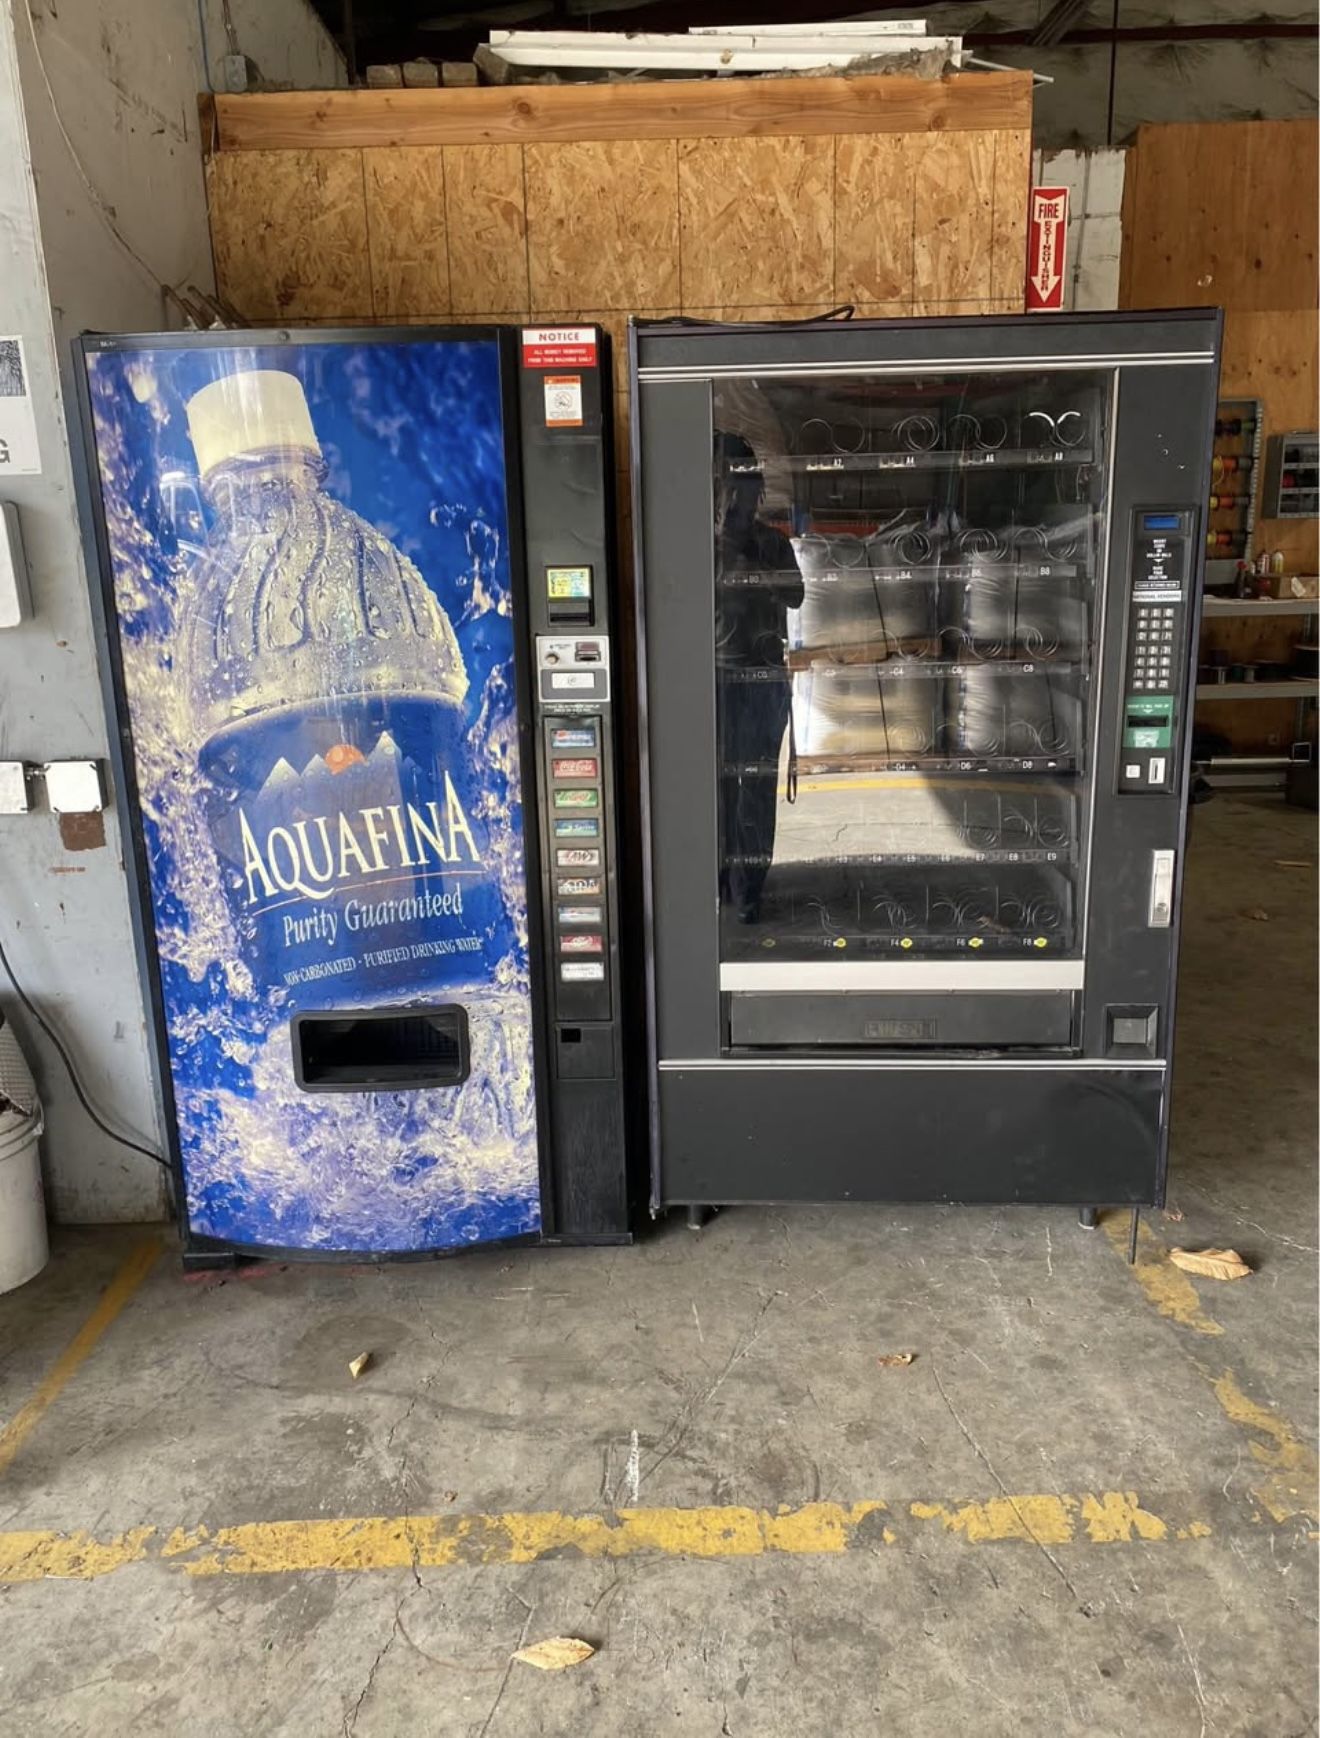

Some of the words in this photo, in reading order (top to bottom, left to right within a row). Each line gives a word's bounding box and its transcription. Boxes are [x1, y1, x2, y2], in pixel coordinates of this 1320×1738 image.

[1038, 203, 1059, 219] FIRE
[1040, 221, 1053, 291] EXTINGUISHER
[539, 332, 580, 341] NOTICE
[239, 771, 481, 904] AQUAFINA
[283, 908, 338, 947] Purity
[344, 883, 464, 932] Guaranteed
[363, 947, 411, 968] PURIFIED
[411, 940, 456, 960] DRINKING
